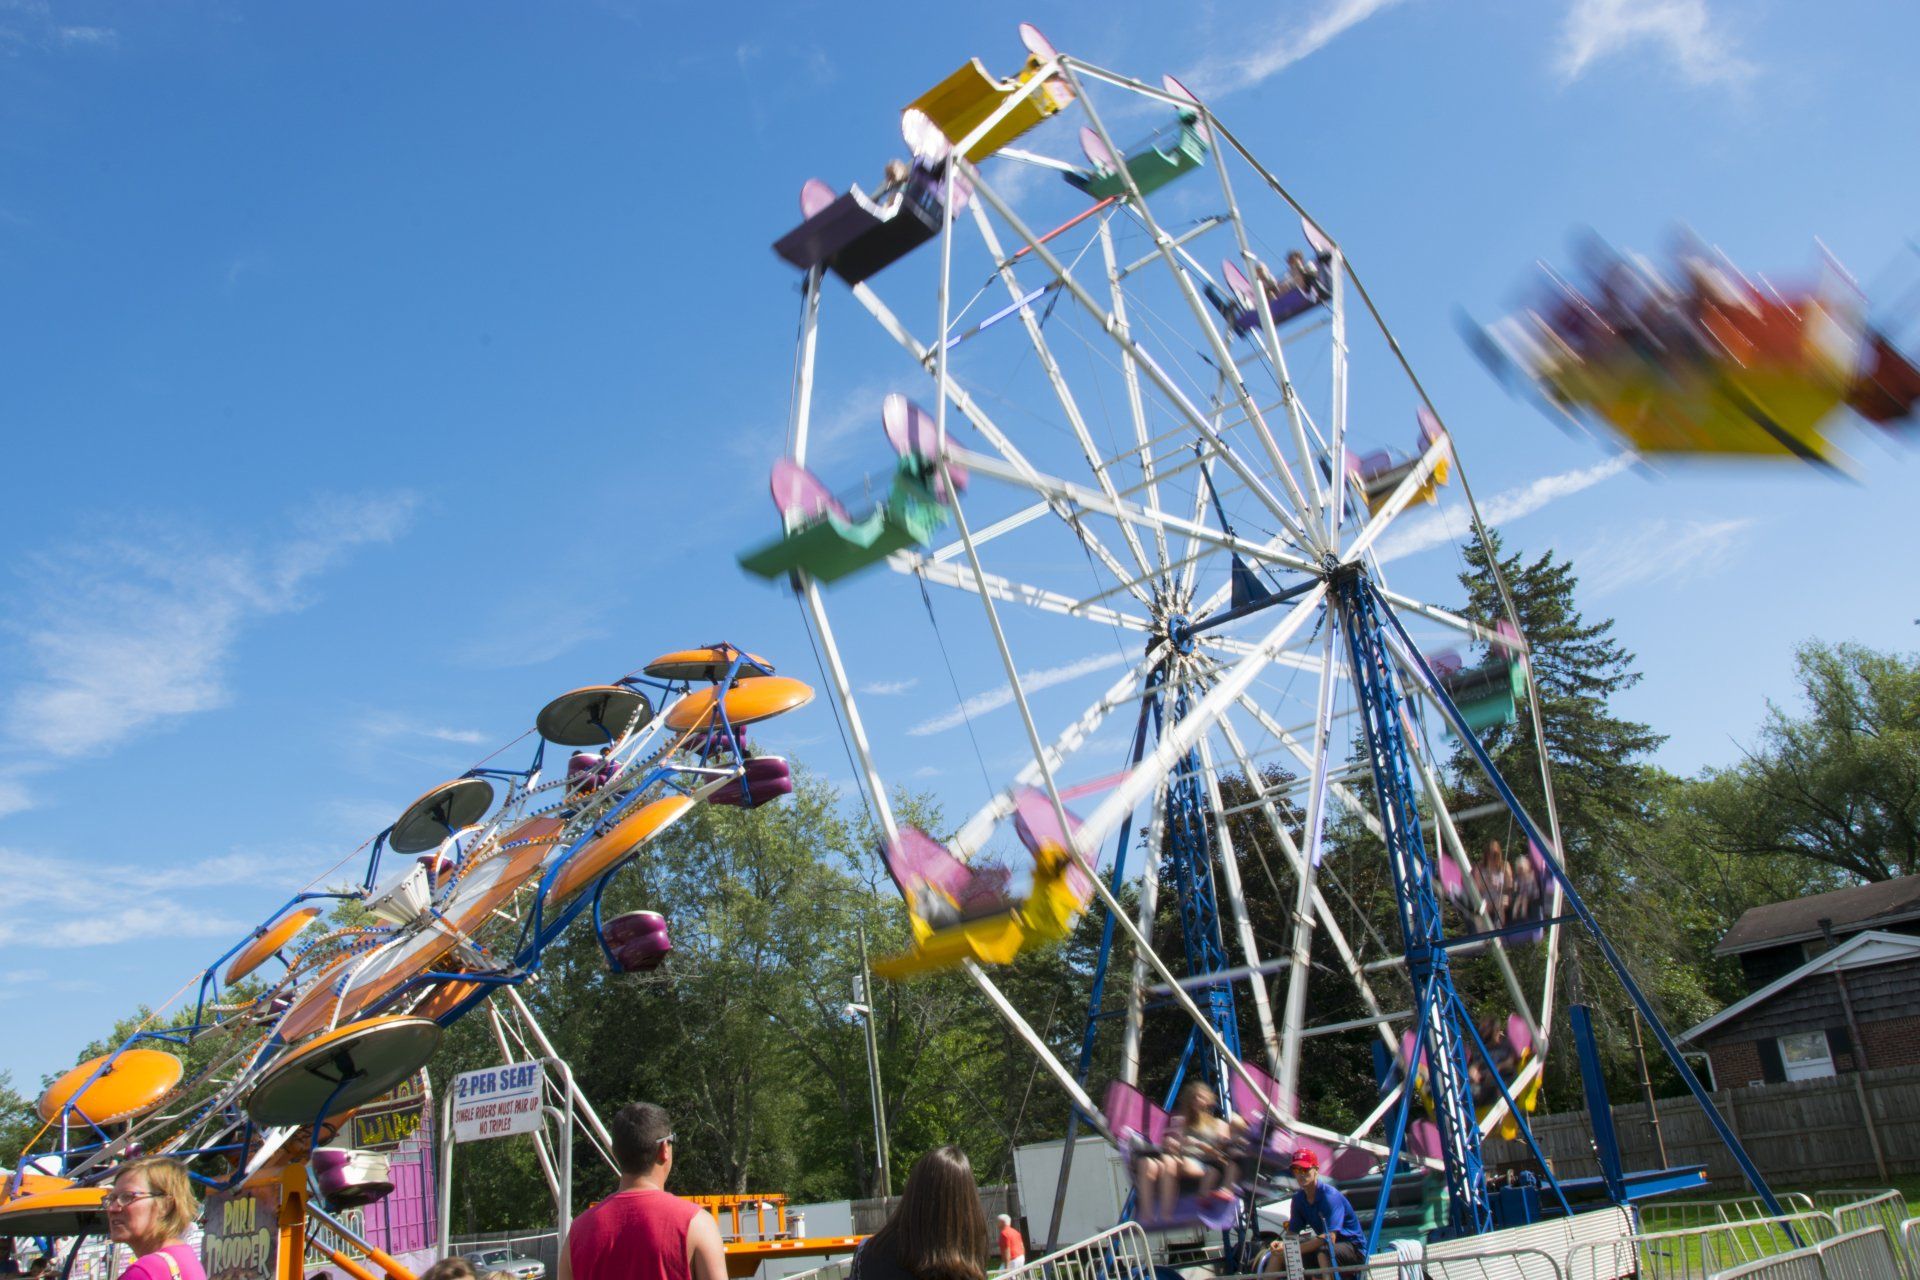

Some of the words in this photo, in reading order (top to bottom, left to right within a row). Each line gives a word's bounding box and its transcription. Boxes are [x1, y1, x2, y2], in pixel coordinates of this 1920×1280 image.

[459, 1078, 467, 1097] 2
[471, 1073, 496, 1096] PER
[500, 1065, 536, 1090] SEAT
[456, 1107, 474, 1122] SINGLE
[476, 1104, 496, 1119] RIDERS
[498, 1101, 513, 1115] MUST
[515, 1099, 527, 1112] PAIR
[530, 1097, 538, 1110] UP
[480, 1123, 487, 1134] NO
[490, 1118, 511, 1131] TRIPLES
[223, 1197, 256, 1236] PARA
[206, 1227, 271, 1280] TROOPER
